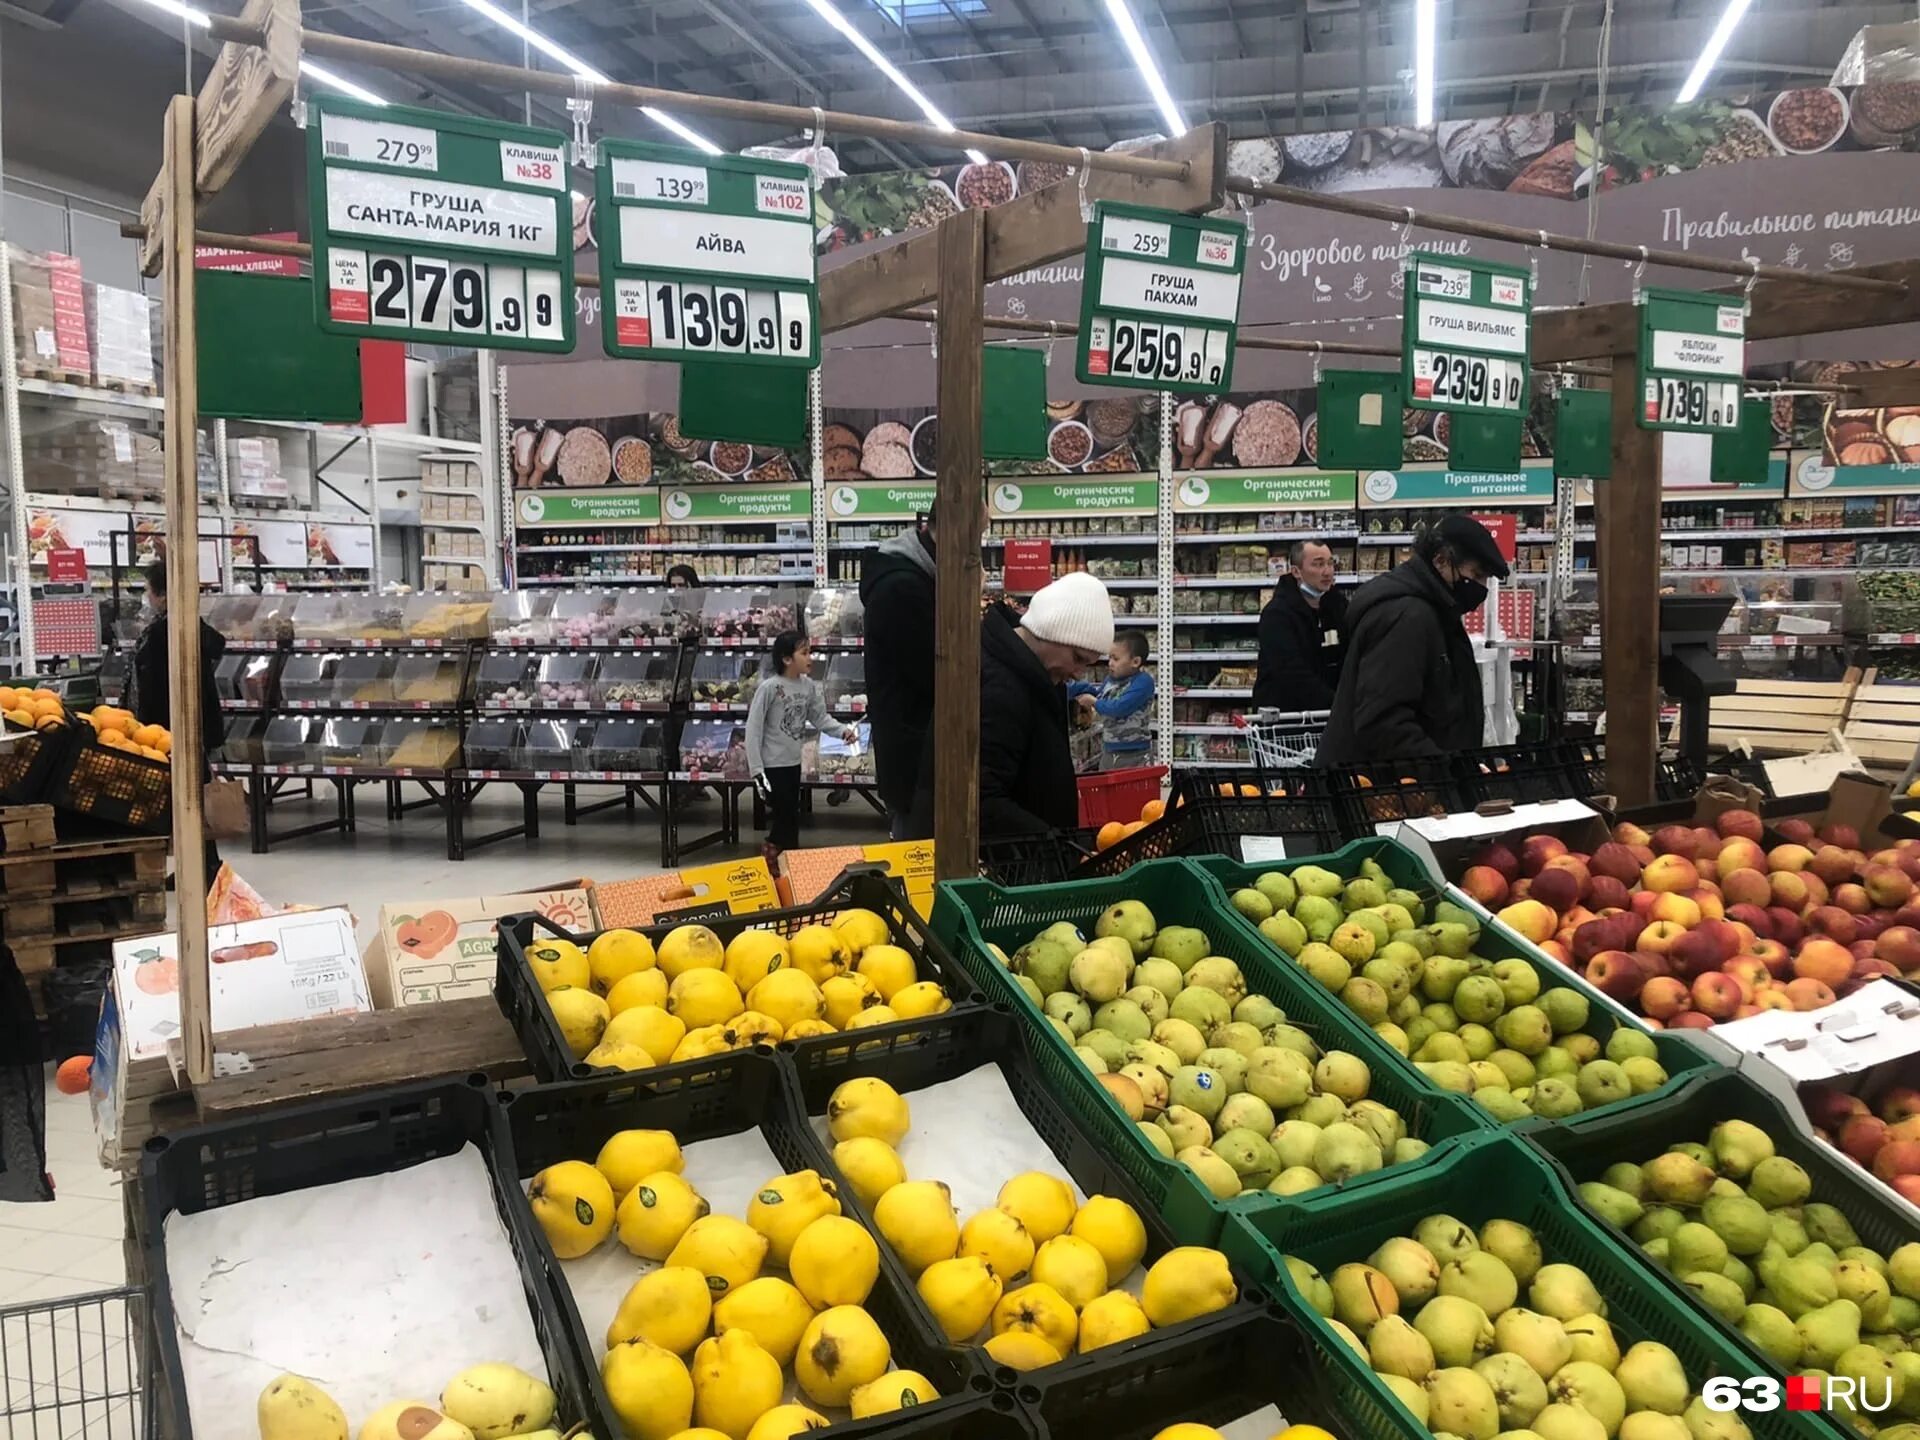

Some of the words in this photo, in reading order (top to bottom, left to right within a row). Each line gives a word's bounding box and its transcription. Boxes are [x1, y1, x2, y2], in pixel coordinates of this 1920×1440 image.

[506, 147, 559, 163] КЛАВИША
[516, 162, 552, 180] №38
[760, 181, 805, 194] КЛАВИША
[409, 190, 484, 214] ГРУША
[765, 194, 804, 210] №102
[347, 204, 501, 237] САНТА-МАРИЯ
[507, 223, 543, 242] 1КГ
[1661, 207, 1816, 249] Правильное
[696, 232, 746, 254] АЙВА
[1202, 235, 1233, 247] КЛАВИША
[335, 259, 359, 269] ЦЕНА
[1260, 234, 1365, 281] Здоровое
[341, 269, 353, 277] ЗА
[1001, 266, 1084, 286] питани
[1151, 273, 1194, 291] ГРУША
[620, 289, 640, 298] ЦЕНА
[1144, 289, 1198, 307] ПАКХАМ
[1429, 315, 1464, 330] ГРУША
[1467, 320, 1516, 337] ВИЛЬЯМС
[1681, 339, 1717, 352] ЯБЛОКИ
[1674, 351, 1724, 365] "ФЛОРИНА"
[1243, 478, 1331, 491] Органические
[1444, 473, 1527, 486] Правильное
[1054, 486, 1135, 498] Органические
[1472, 483, 1527, 493] питание
[719, 494, 791, 505] Органические
[1075, 496, 1134, 508] продукты
[1267, 489, 1331, 502] продукты
[571, 497, 640, 510] Органические
[739, 503, 791, 514] продукты
[590, 507, 641, 518] продукты
